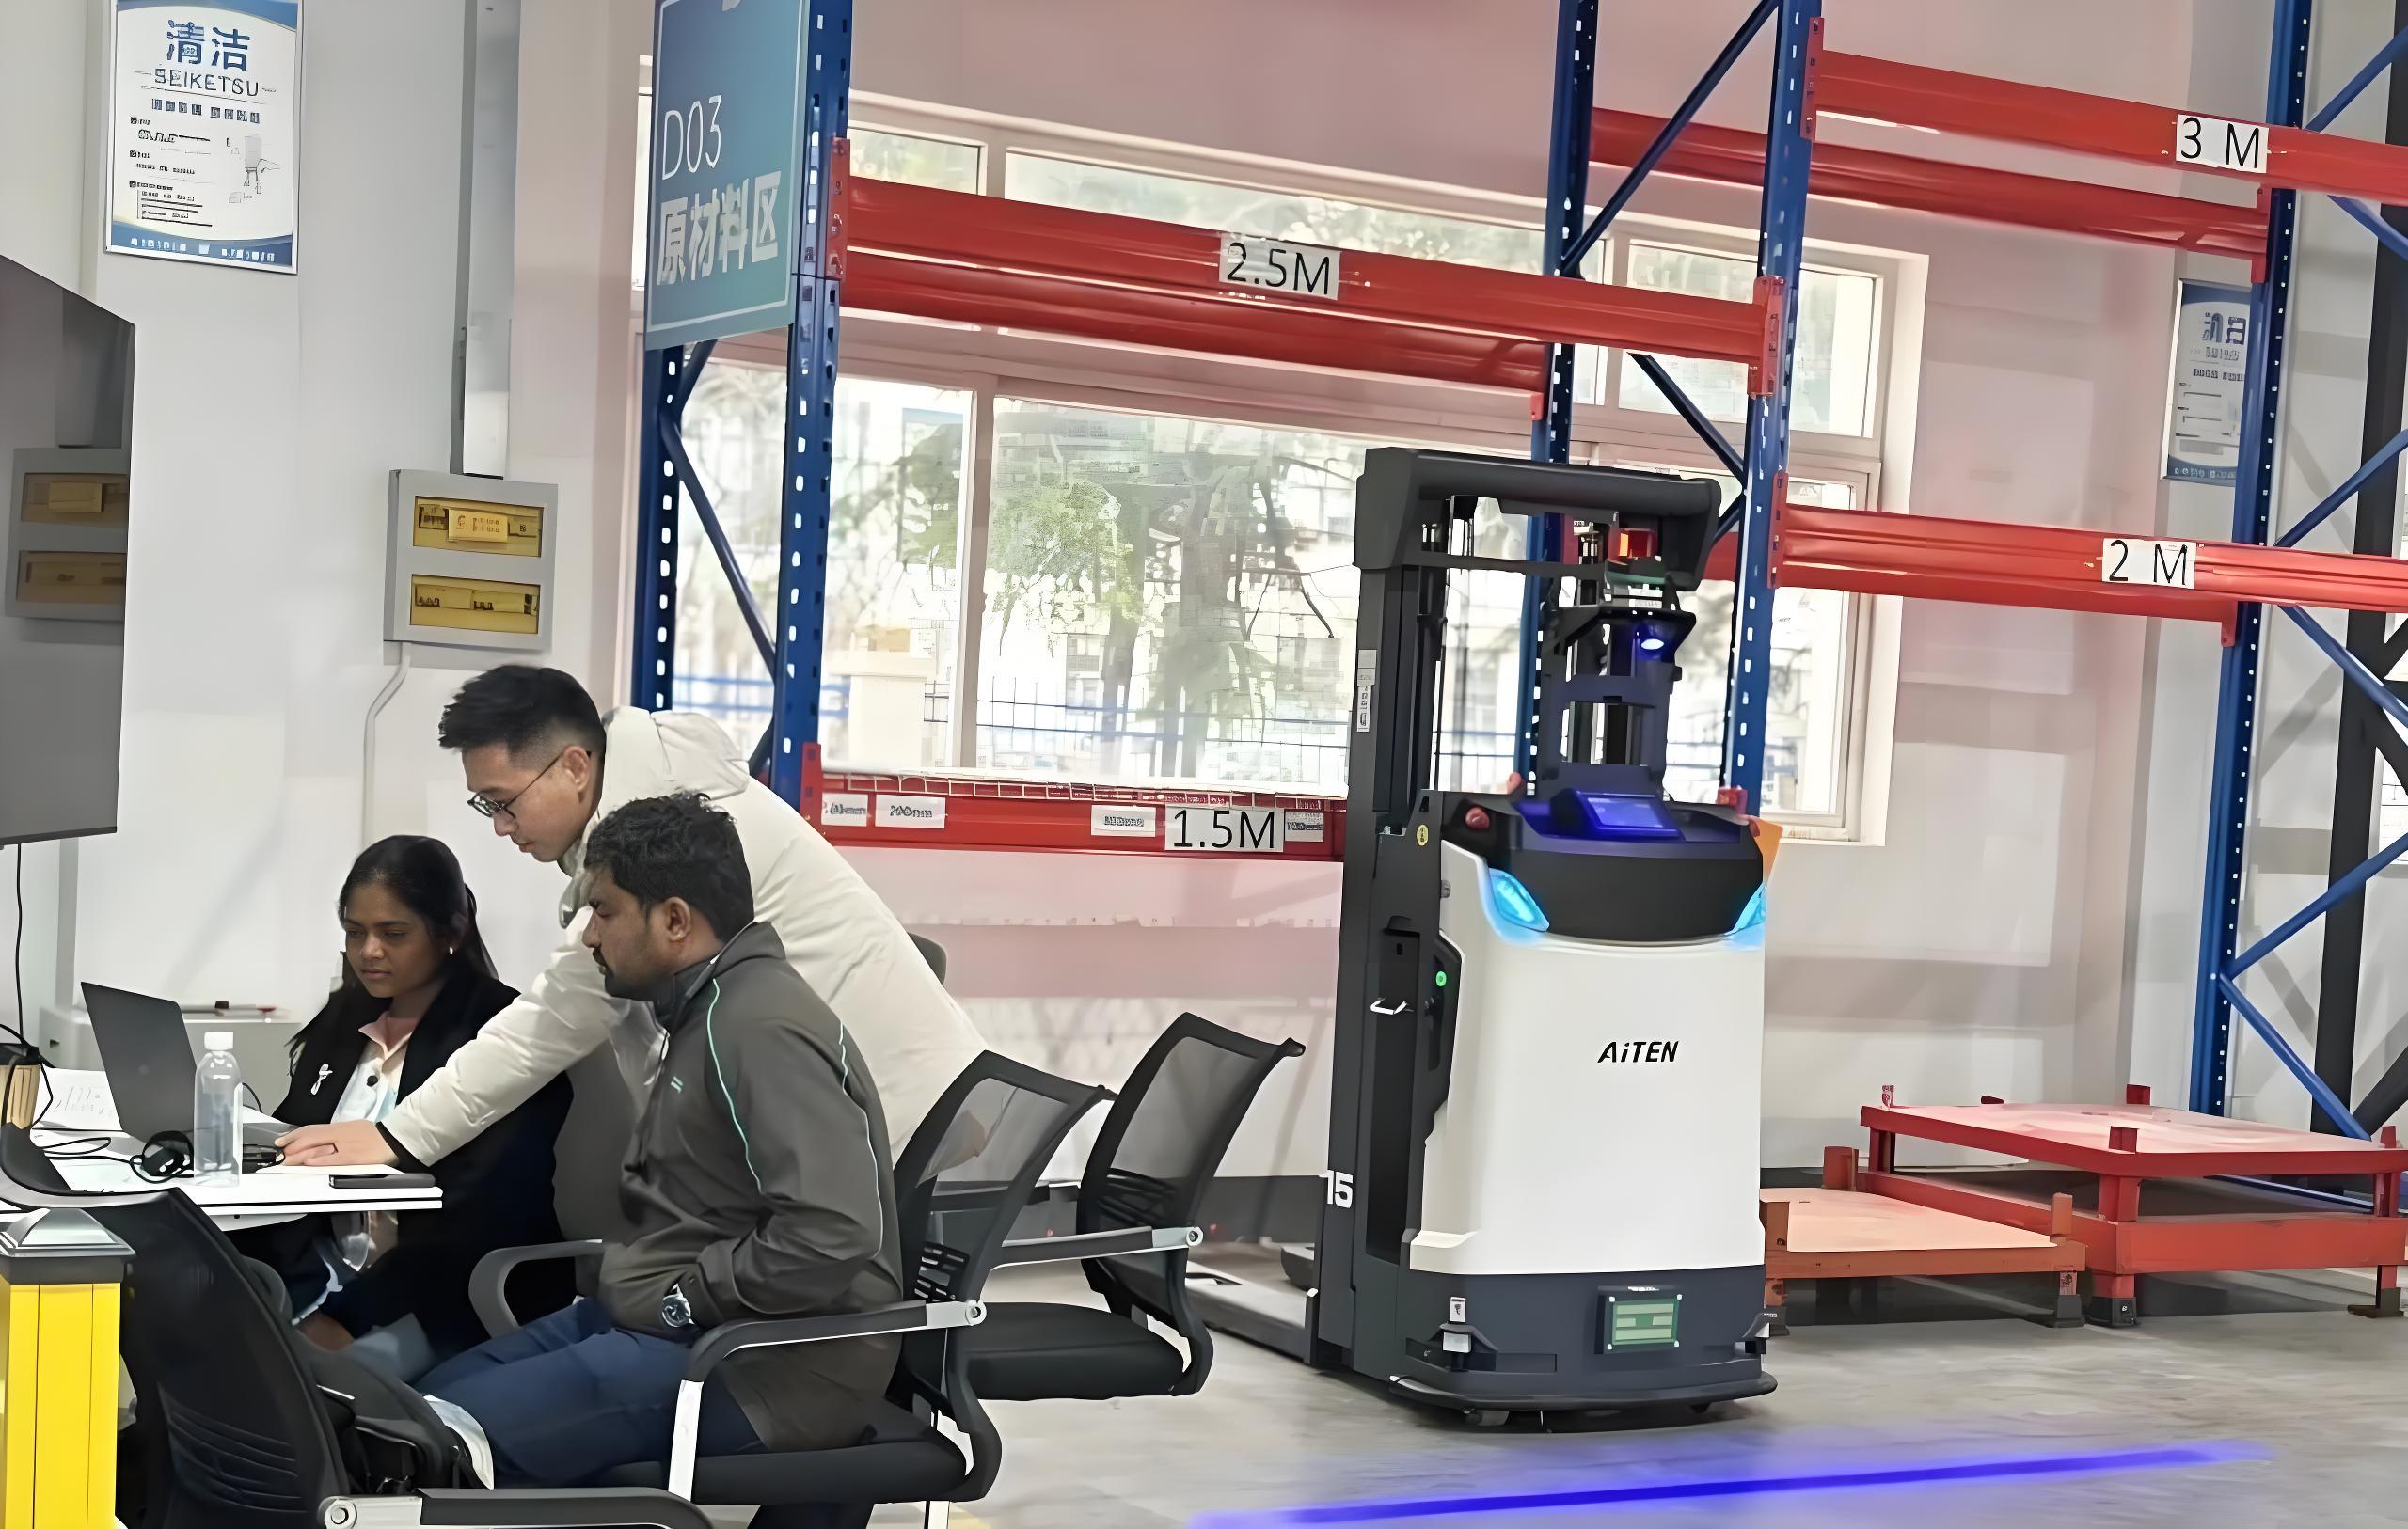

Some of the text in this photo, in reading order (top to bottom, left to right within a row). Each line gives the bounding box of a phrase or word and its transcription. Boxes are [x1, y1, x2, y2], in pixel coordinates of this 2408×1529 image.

[166, 19, 251, 72] 清洁
[154, 68, 259, 97] SEIKETSU
[662, 94, 722, 181] D03
[2181, 117, 2259, 169] 3 M
[657, 170, 783, 286] 原材料区
[1227, 242, 1330, 295] 2.5M
[2109, 539, 2188, 585] 2 M
[1173, 809, 1275, 849] 1.5M
[1597, 1041, 1679, 1063] AiTEN
[1318, 1169, 1354, 1209] 15
